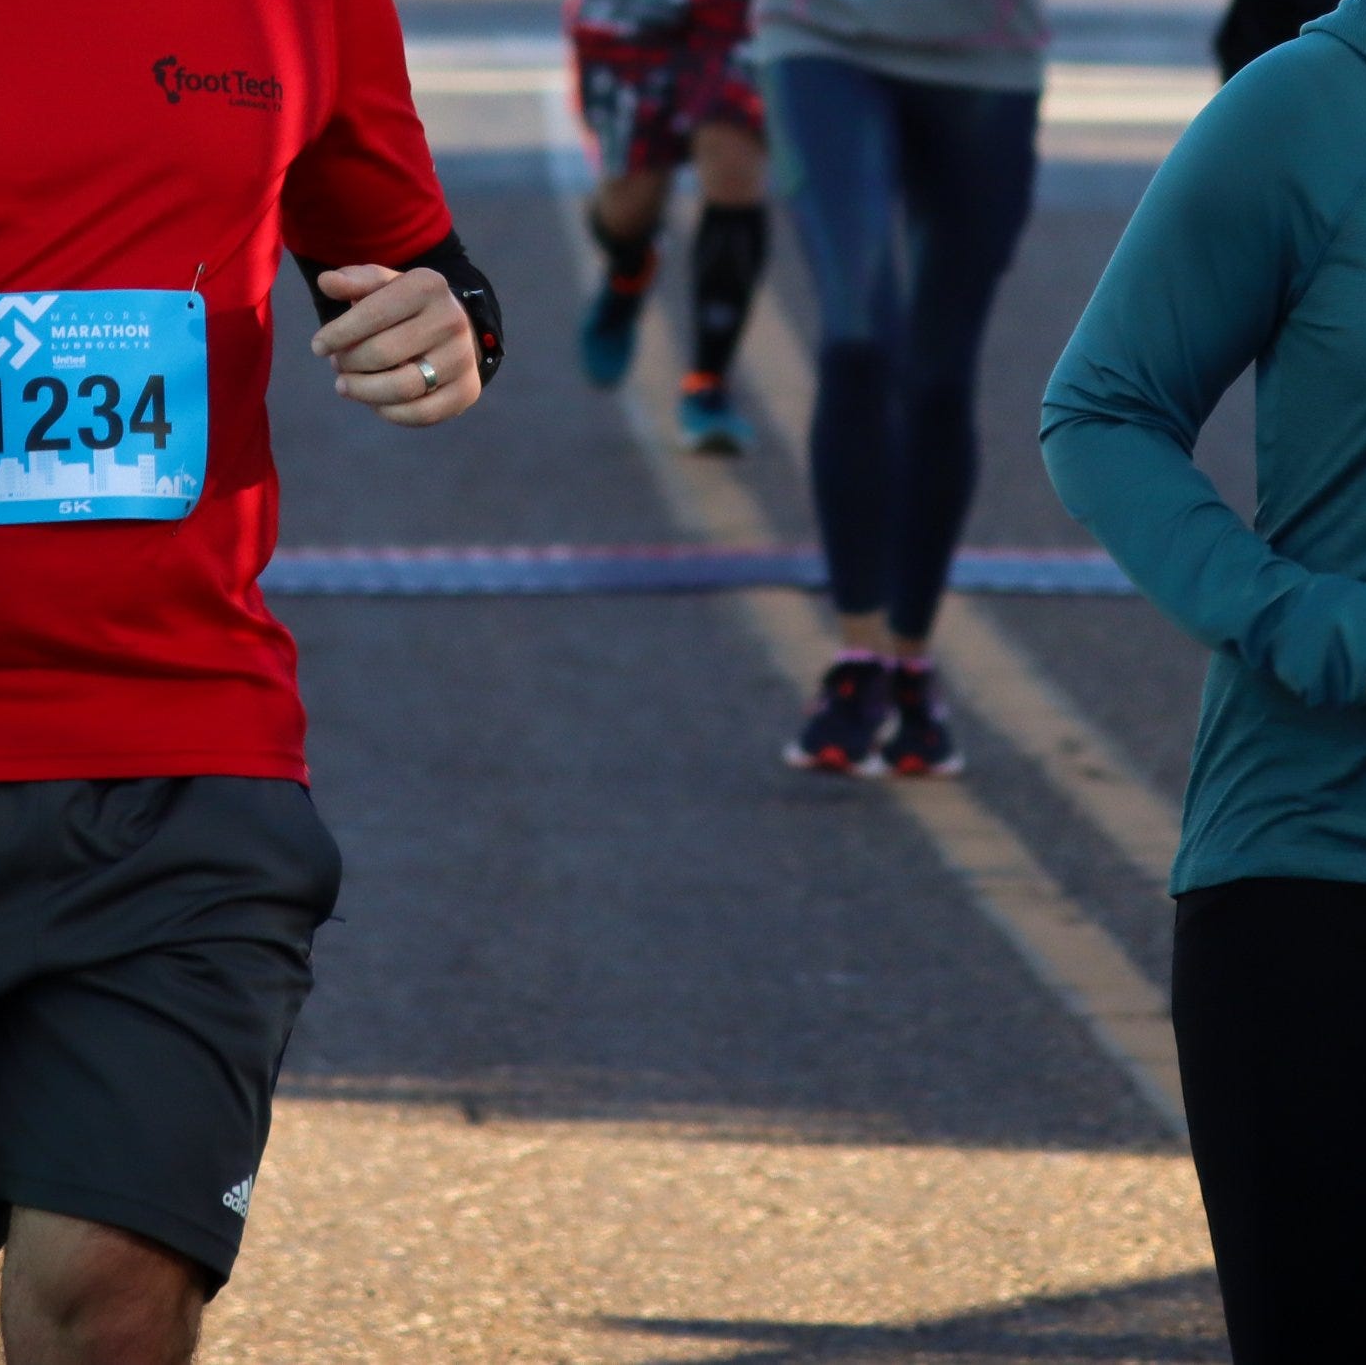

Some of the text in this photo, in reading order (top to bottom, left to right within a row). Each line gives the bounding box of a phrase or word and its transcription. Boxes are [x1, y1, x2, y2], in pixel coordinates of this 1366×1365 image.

[51, 324, 150, 339] MARATHON
[52, 355, 86, 365] United
[59, 501, 92, 514] 5K
